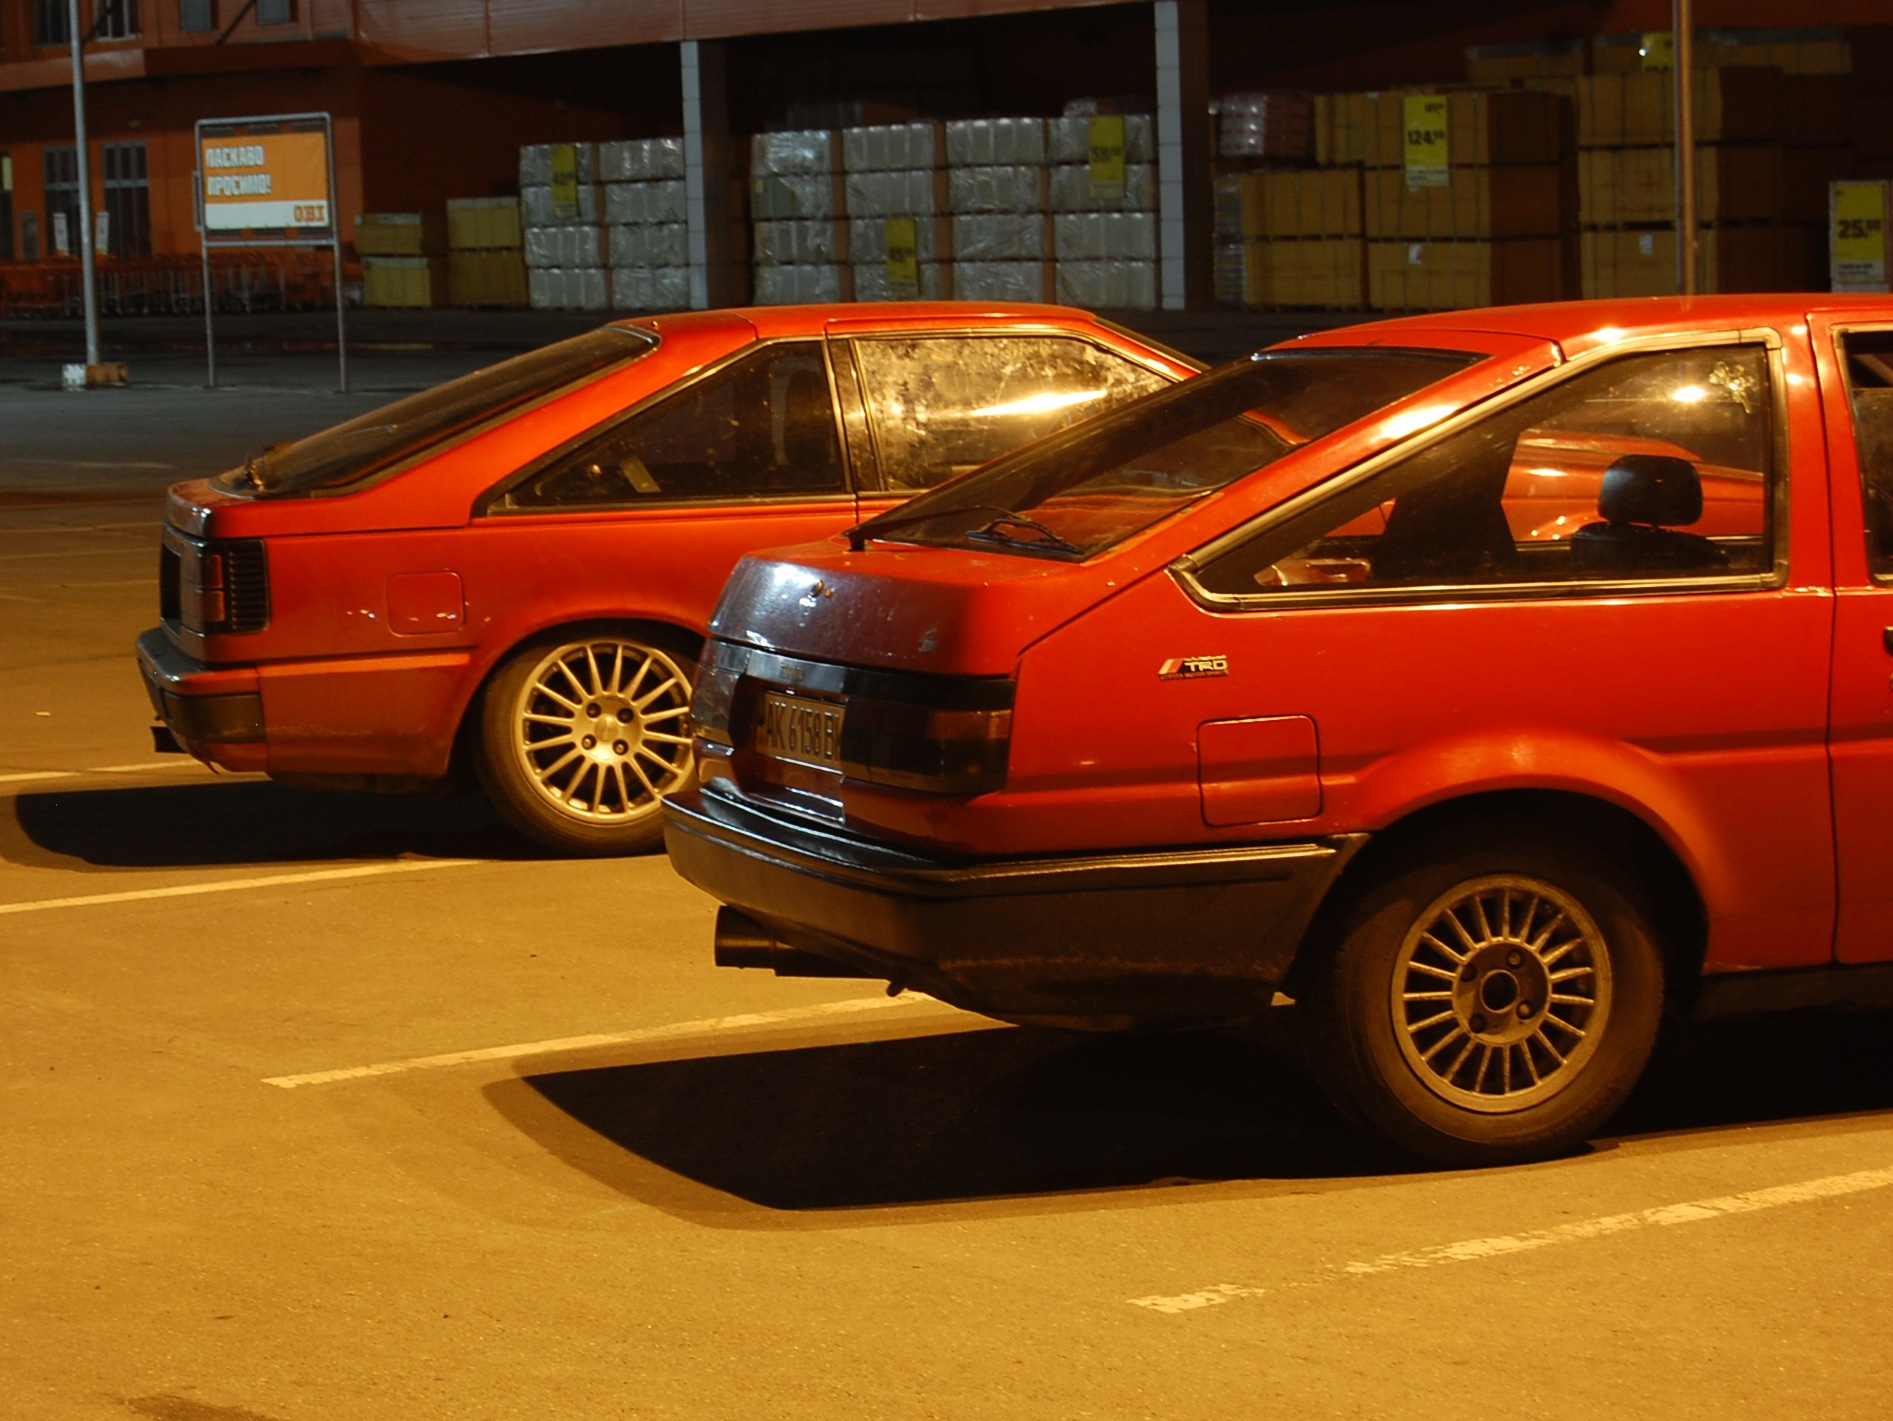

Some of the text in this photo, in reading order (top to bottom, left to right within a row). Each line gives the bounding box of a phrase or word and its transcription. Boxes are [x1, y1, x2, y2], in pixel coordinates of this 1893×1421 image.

[207, 173, 272, 196] ПРОСИМО!
[294, 204, 326, 223] OBI
[1183, 660, 1228, 672] TRD
[788, 705, 821, 757] 6158
